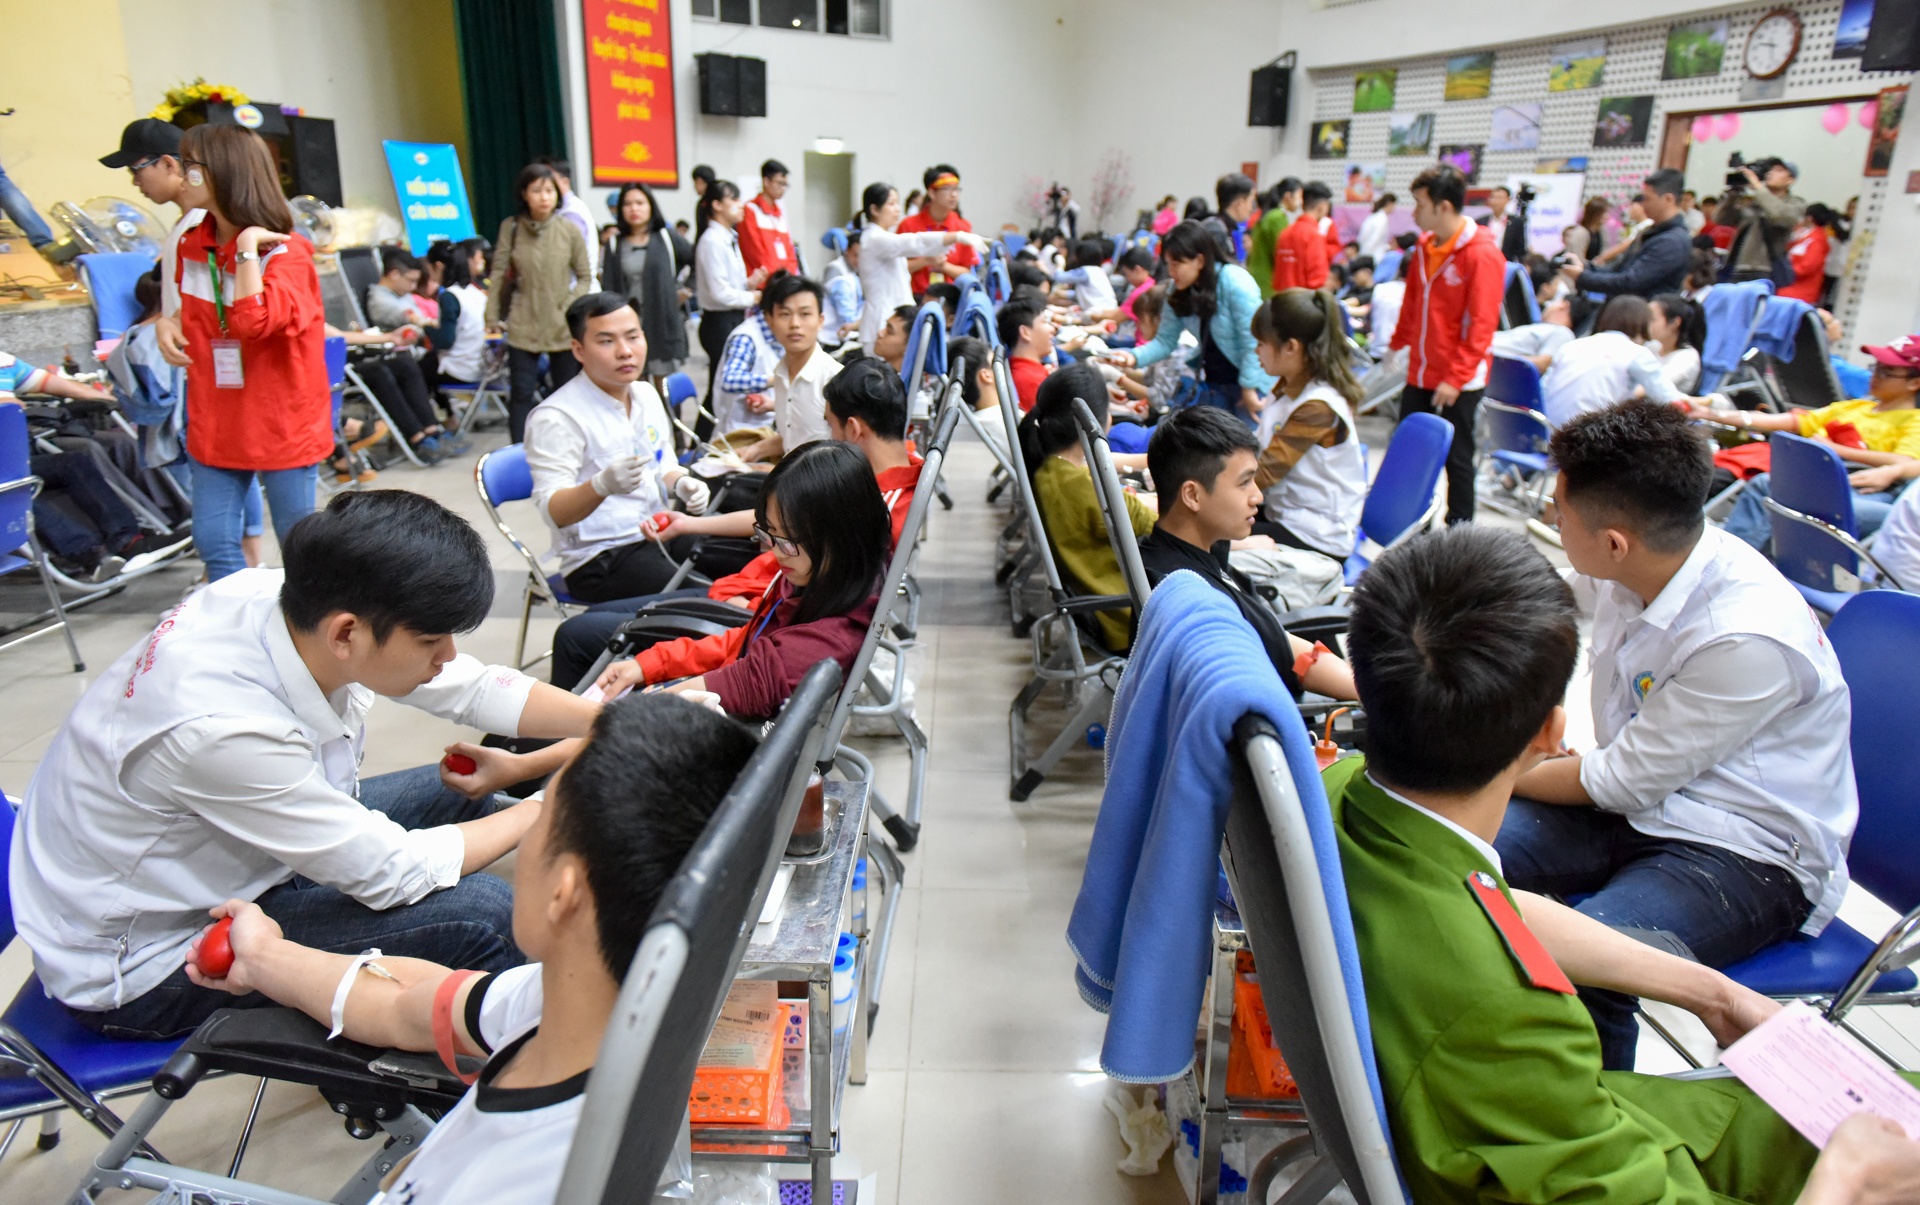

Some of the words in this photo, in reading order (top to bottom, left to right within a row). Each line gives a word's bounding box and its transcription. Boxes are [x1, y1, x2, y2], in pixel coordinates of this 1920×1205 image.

[405, 175, 428, 196] HIẾN
[429, 178, 450, 196] MÁU
[407, 201, 428, 221] CỨU
[429, 201, 460, 221] NGƯỜI
